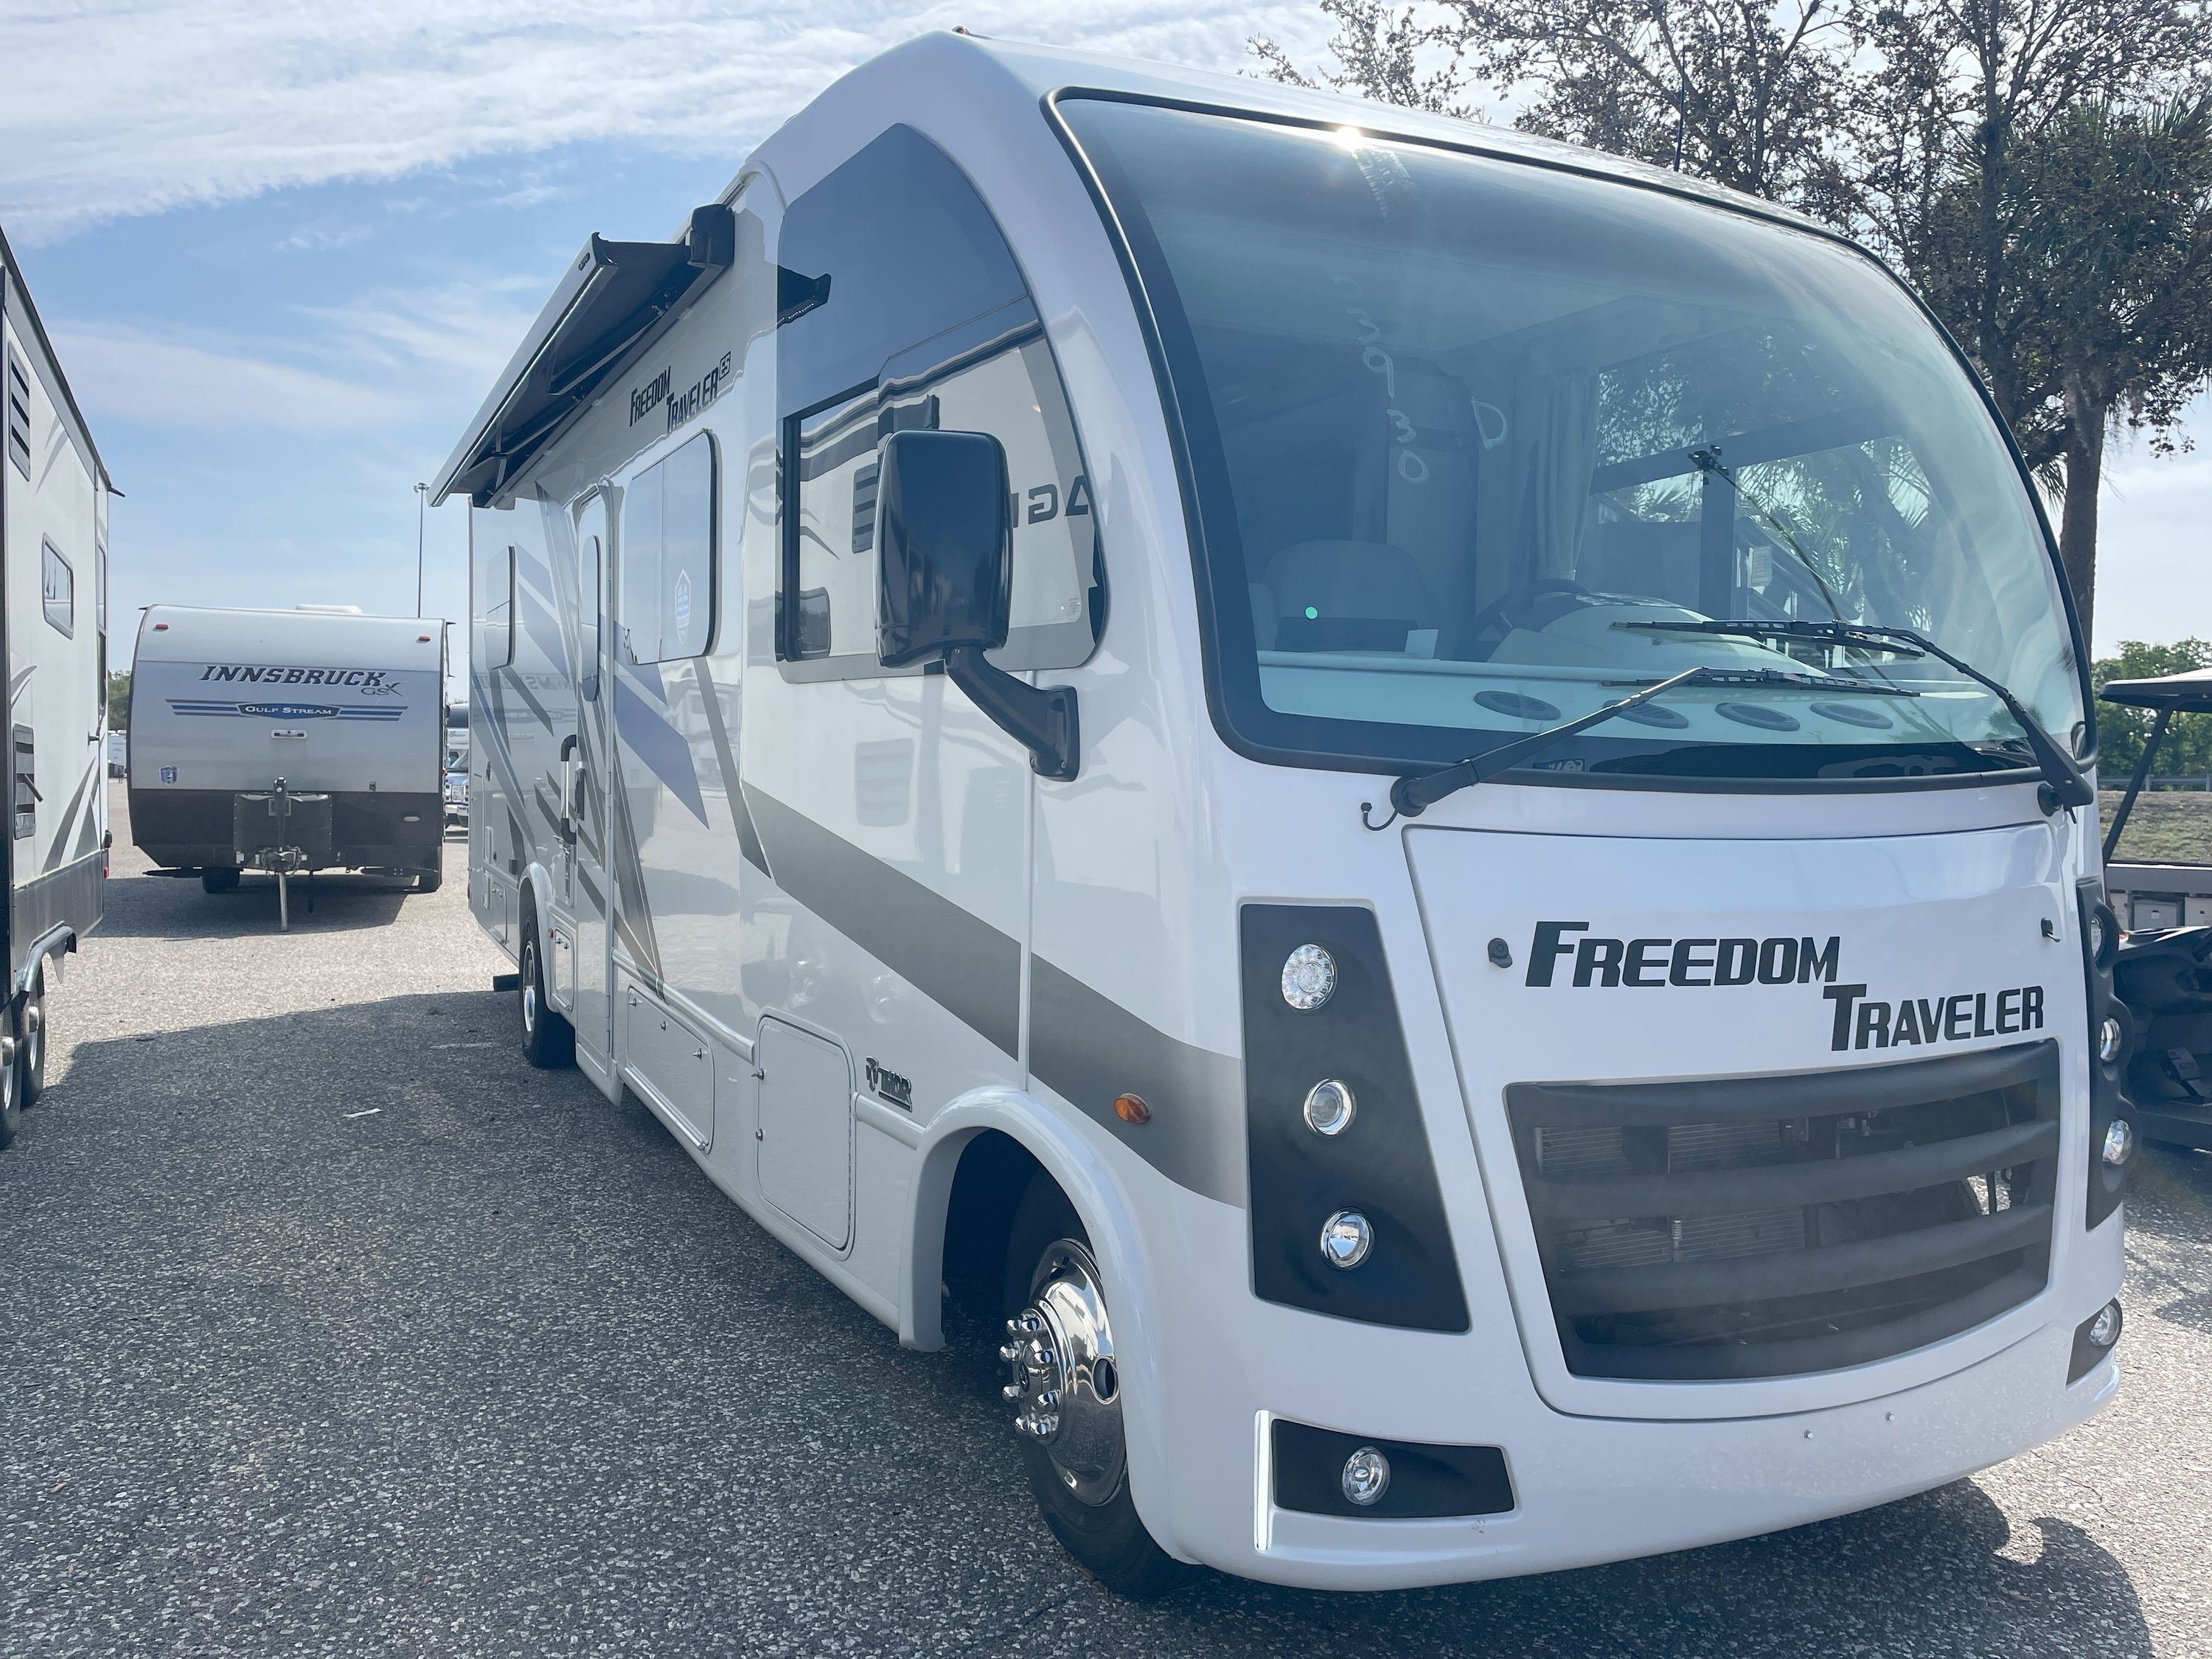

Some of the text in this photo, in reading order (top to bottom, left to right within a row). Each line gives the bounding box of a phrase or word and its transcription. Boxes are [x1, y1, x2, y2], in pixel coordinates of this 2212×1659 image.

[630, 365, 671, 427] FREEDOM
[667, 366, 719, 434] TRAVELER
[1471, 396, 1509, 451] D
[198, 665, 388, 686] INNSBRUCK
[282, 706, 333, 714] STREAM
[1526, 921, 1841, 987] FREEDOM
[1823, 983, 2045, 1051] TRAVELER
[877, 1066, 911, 1105] THOR
